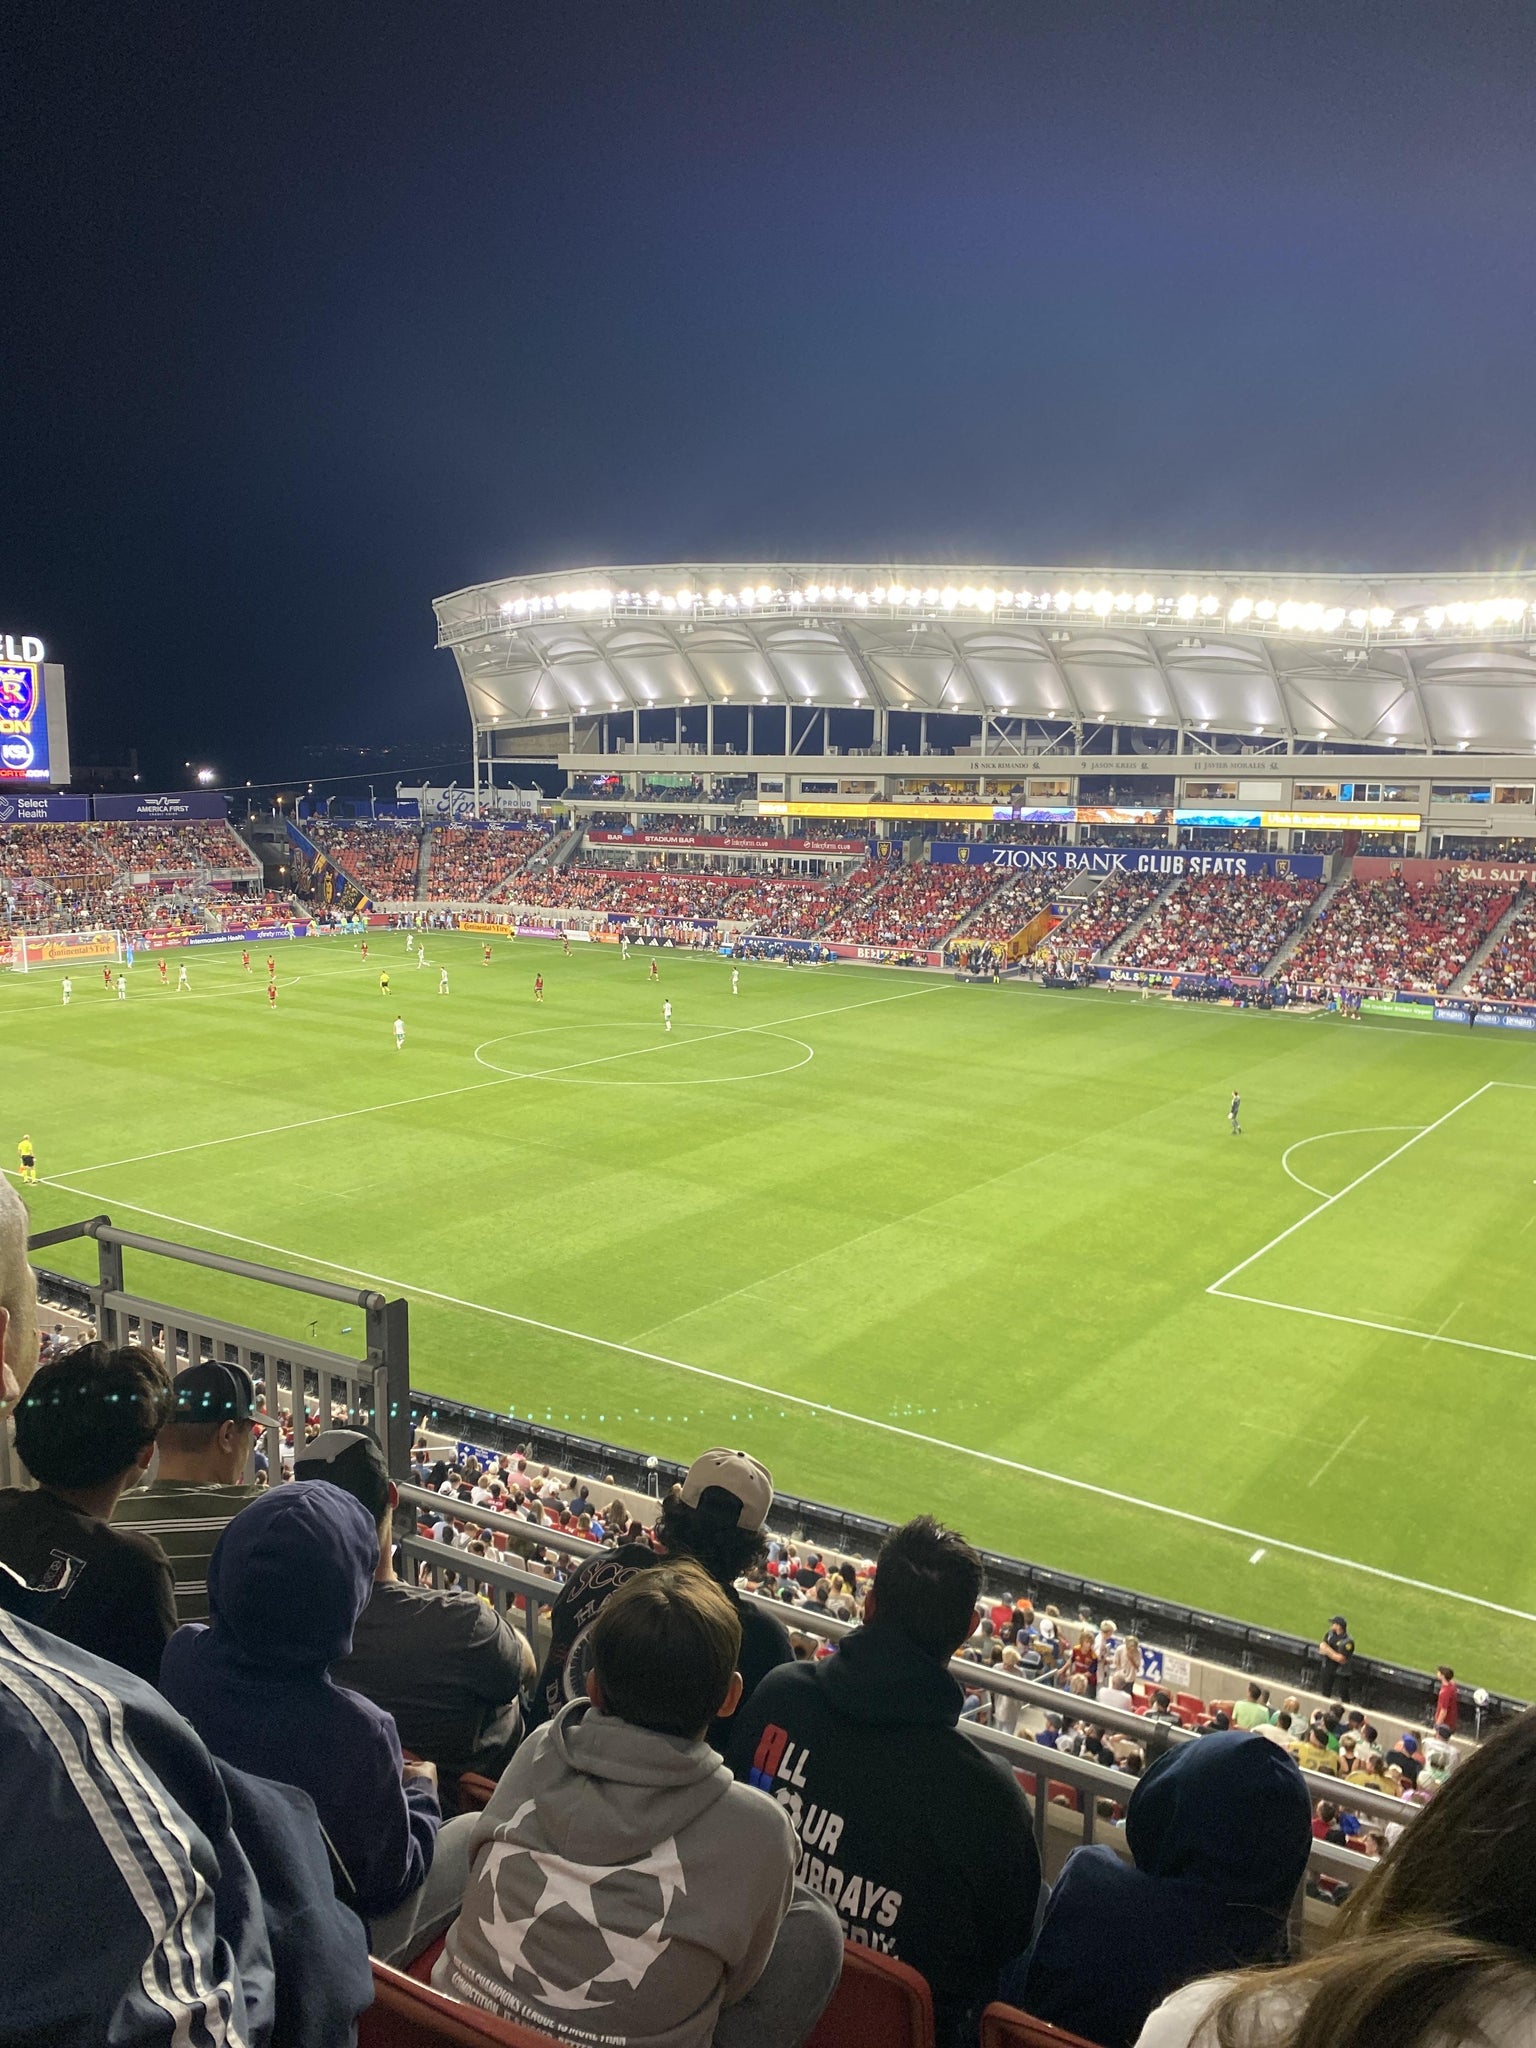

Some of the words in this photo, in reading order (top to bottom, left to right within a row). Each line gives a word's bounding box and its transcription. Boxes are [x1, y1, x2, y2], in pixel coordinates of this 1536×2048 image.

[1091, 762, 1113, 770] JASON
[1204, 762, 1228, 770] JAVIER
[18, 799, 48, 808] Select
[18, 809, 48, 818] Health
[992, 849, 1057, 868] ZIONS
[1065, 852, 1128, 871] BANK
[1138, 855, 1184, 875] CLUB
[1190, 857, 1247, 876] SEATS
[1490, 868, 1528, 882] SALT
[464, 923, 492, 931] Continental
[257, 930, 275, 938] xfinity
[190, 935, 227, 944] Intermountain
[48, 946, 88, 958] Continental
[95, 944, 111, 953] Tire
[750, 1723, 810, 1792] ALL
[795, 1852, 903, 1927] URDAYS
[475, 1972, 521, 2012] CHAMPIONS
[521, 2005, 555, 2028] LEAGUE
[599, 2034, 627, 2046] THAN
